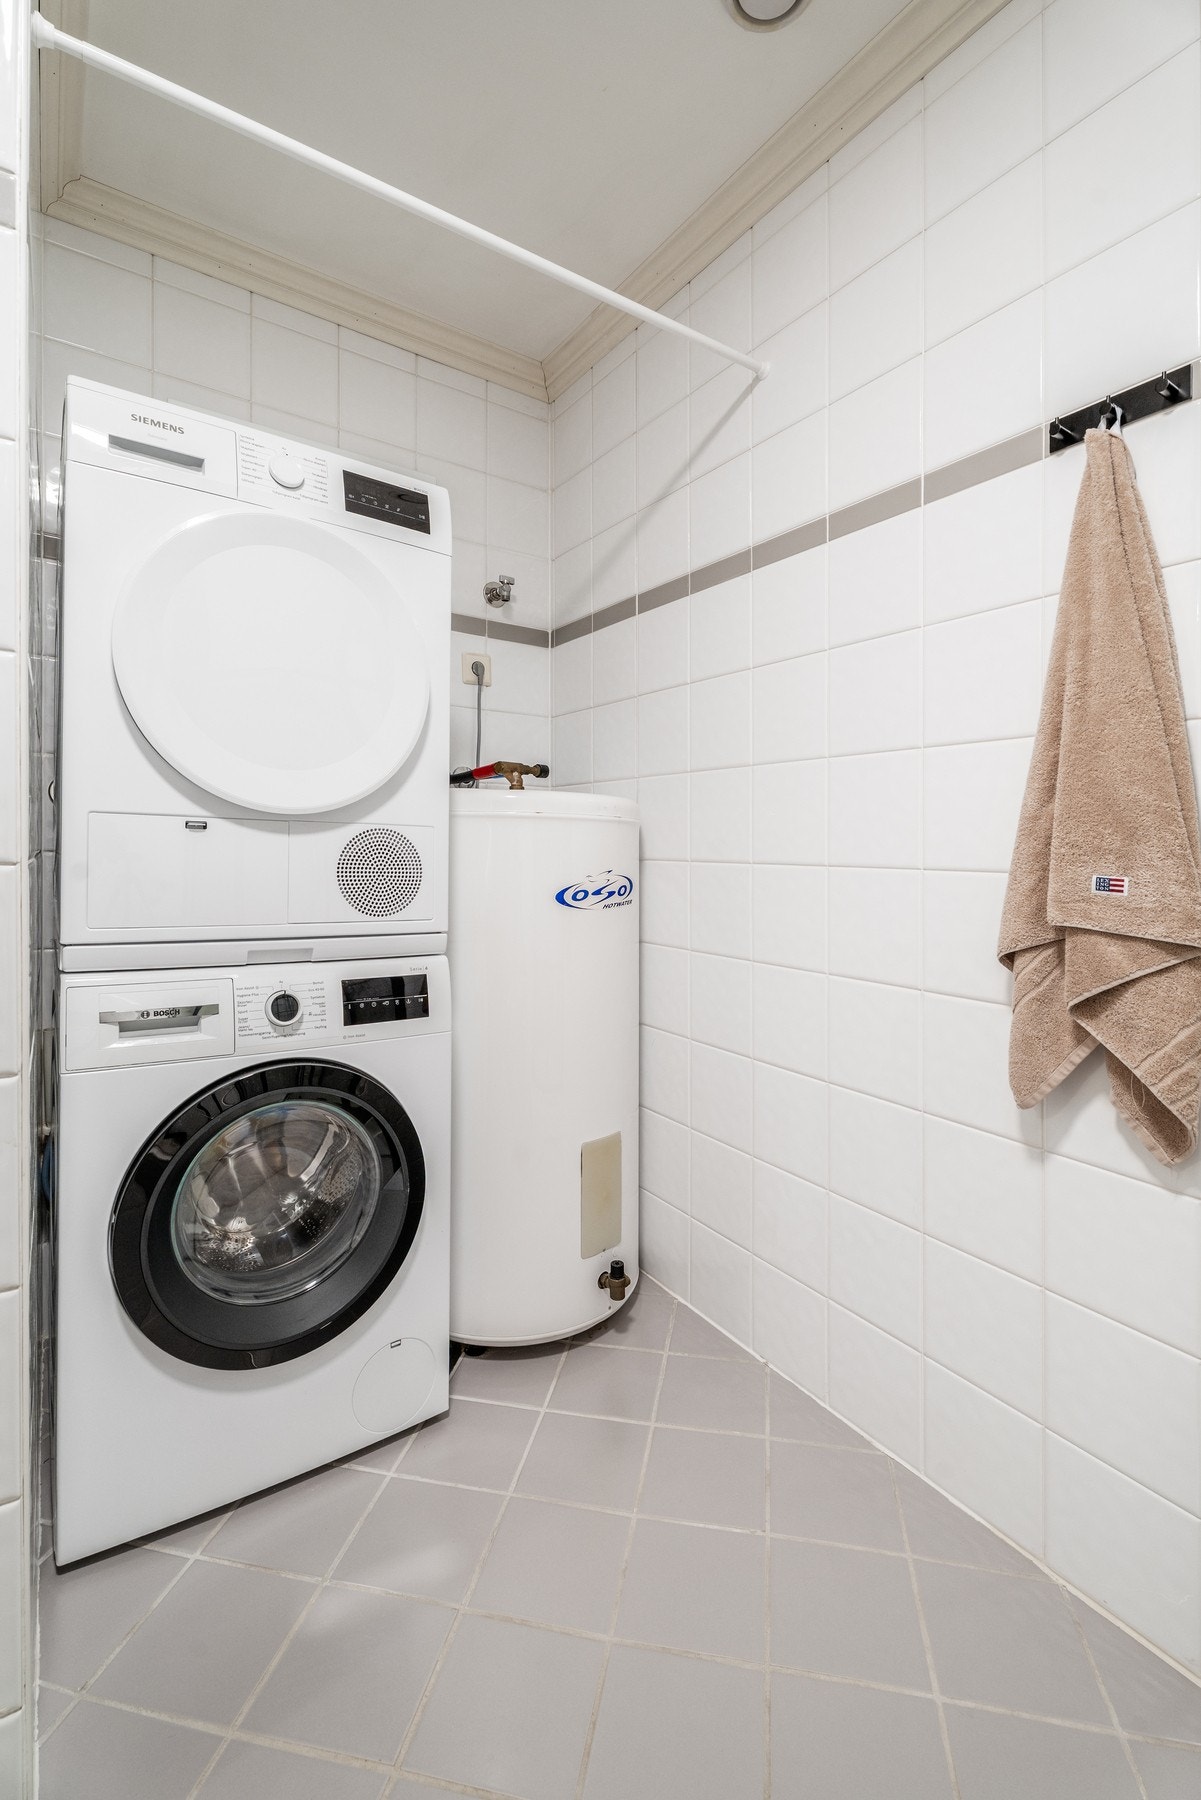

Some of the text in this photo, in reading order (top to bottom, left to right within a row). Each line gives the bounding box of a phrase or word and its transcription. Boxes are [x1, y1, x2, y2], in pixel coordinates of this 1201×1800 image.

[131, 413, 185, 434] SIEMENS
[602, 900, 633, 909] HOTWATER
[153, 1009, 180, 1017] BOSCH
